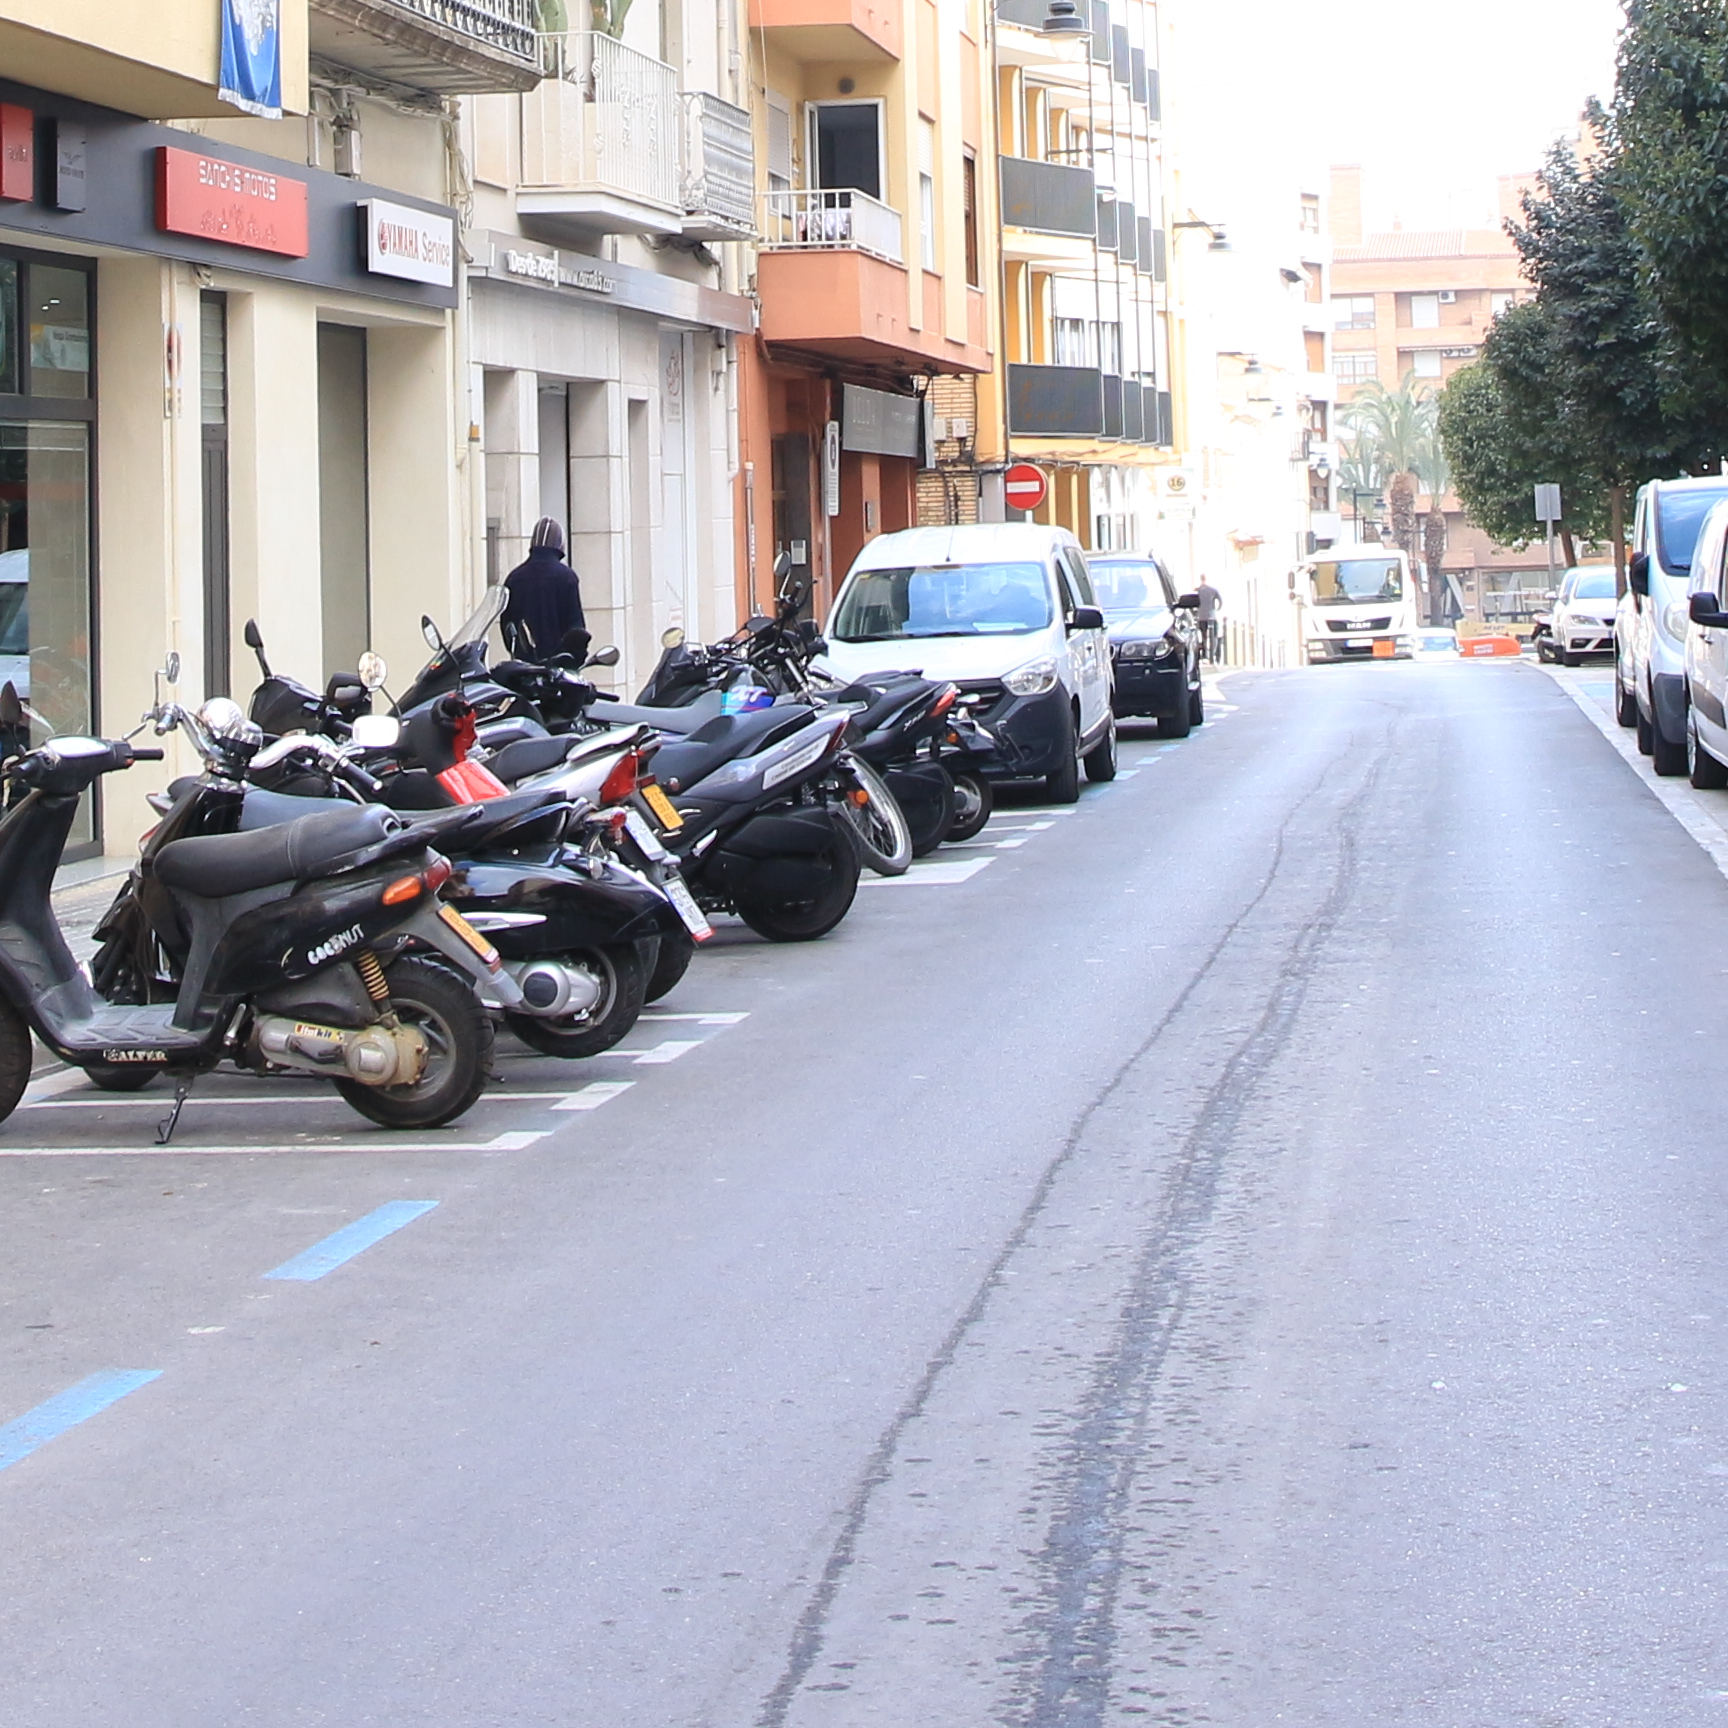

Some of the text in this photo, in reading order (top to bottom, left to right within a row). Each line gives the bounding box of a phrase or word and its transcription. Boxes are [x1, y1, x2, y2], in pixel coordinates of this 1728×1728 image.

[387, 221, 451, 267] YAMAHA Service
[730, 685, 767, 702] XT
